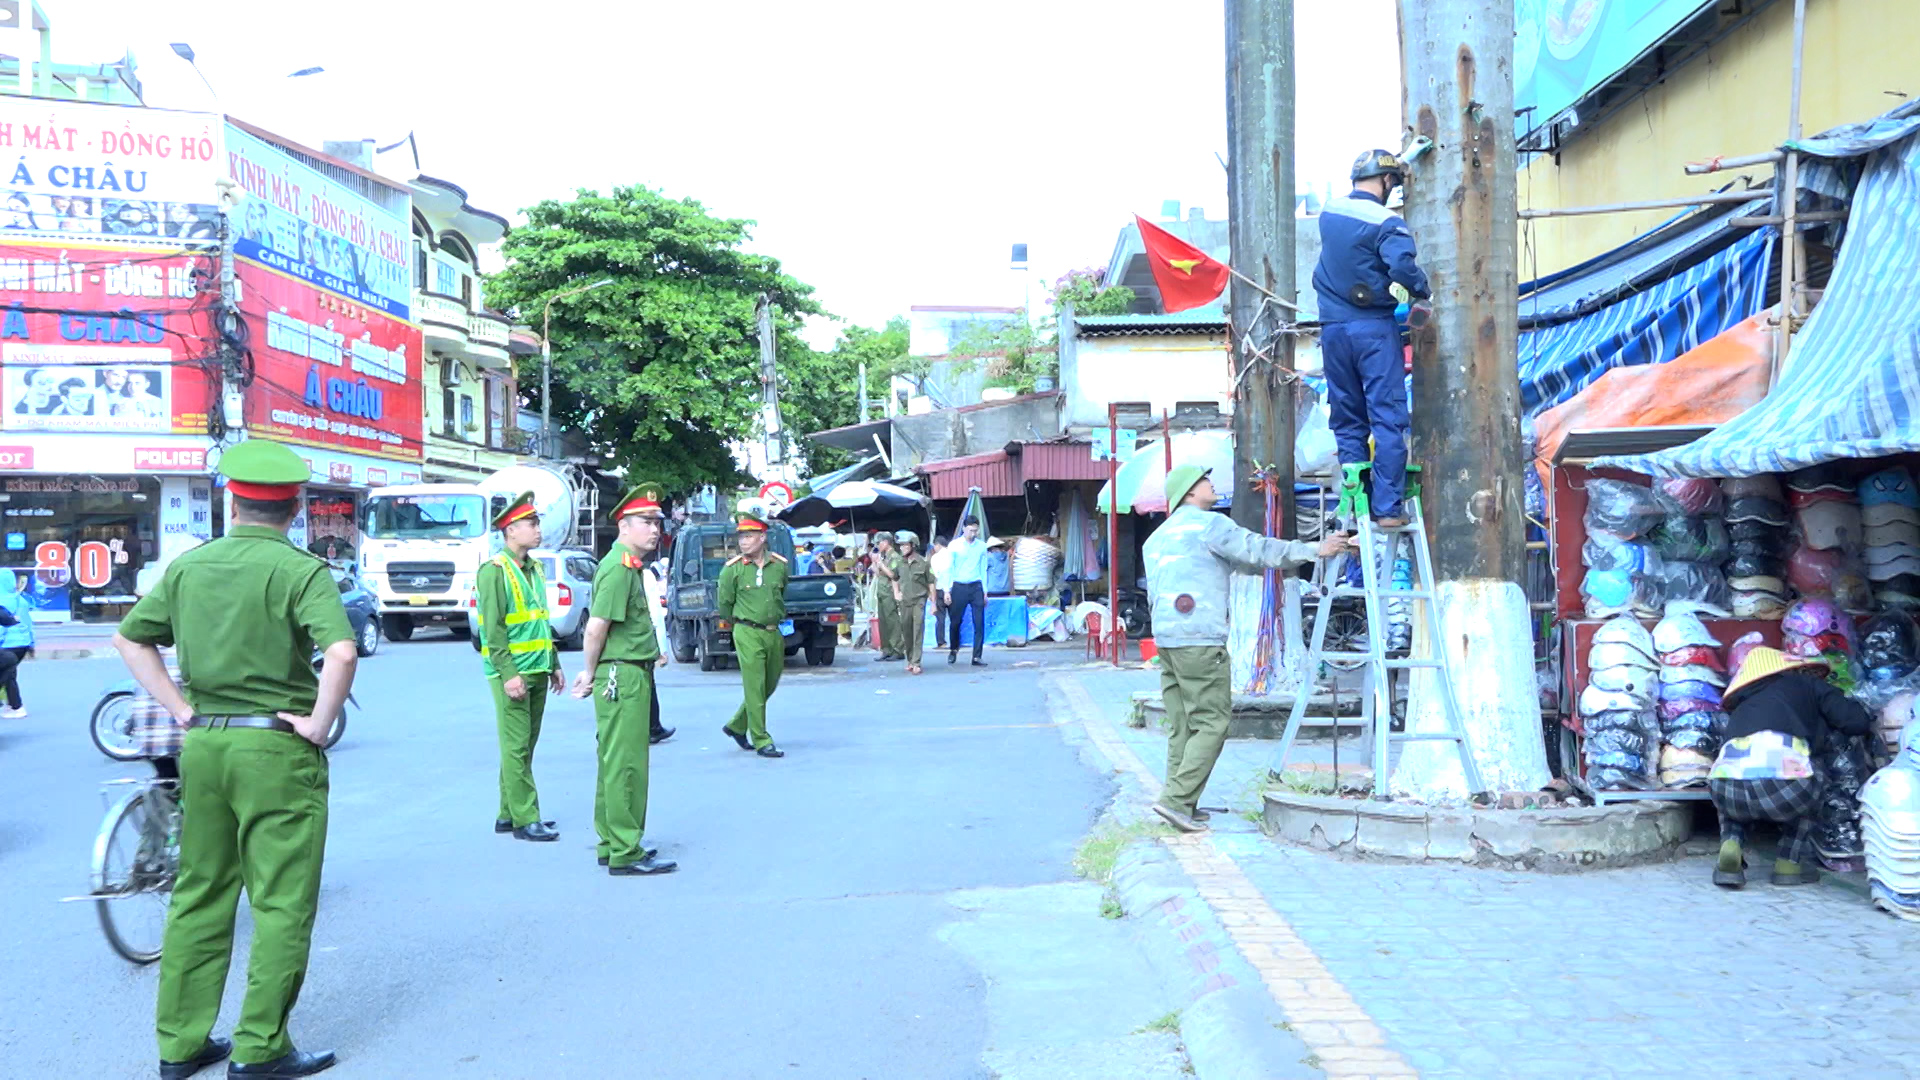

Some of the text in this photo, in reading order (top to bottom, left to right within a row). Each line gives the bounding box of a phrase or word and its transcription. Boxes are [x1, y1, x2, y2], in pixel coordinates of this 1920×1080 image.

[23, 113, 77, 151] MẮT
[101, 119, 171, 158] ĐỒNG
[181, 125, 213, 161] HỒ
[9, 155, 147, 192] Á CHÂU
[229, 147, 267, 199] KÍNH
[59, 305, 164, 343] CHÂU
[304, 363, 322, 408] Á
[328, 377, 383, 421] CHÂU
[135, 450, 203, 465] POLICE
[35, 538, 129, 588] 80%
